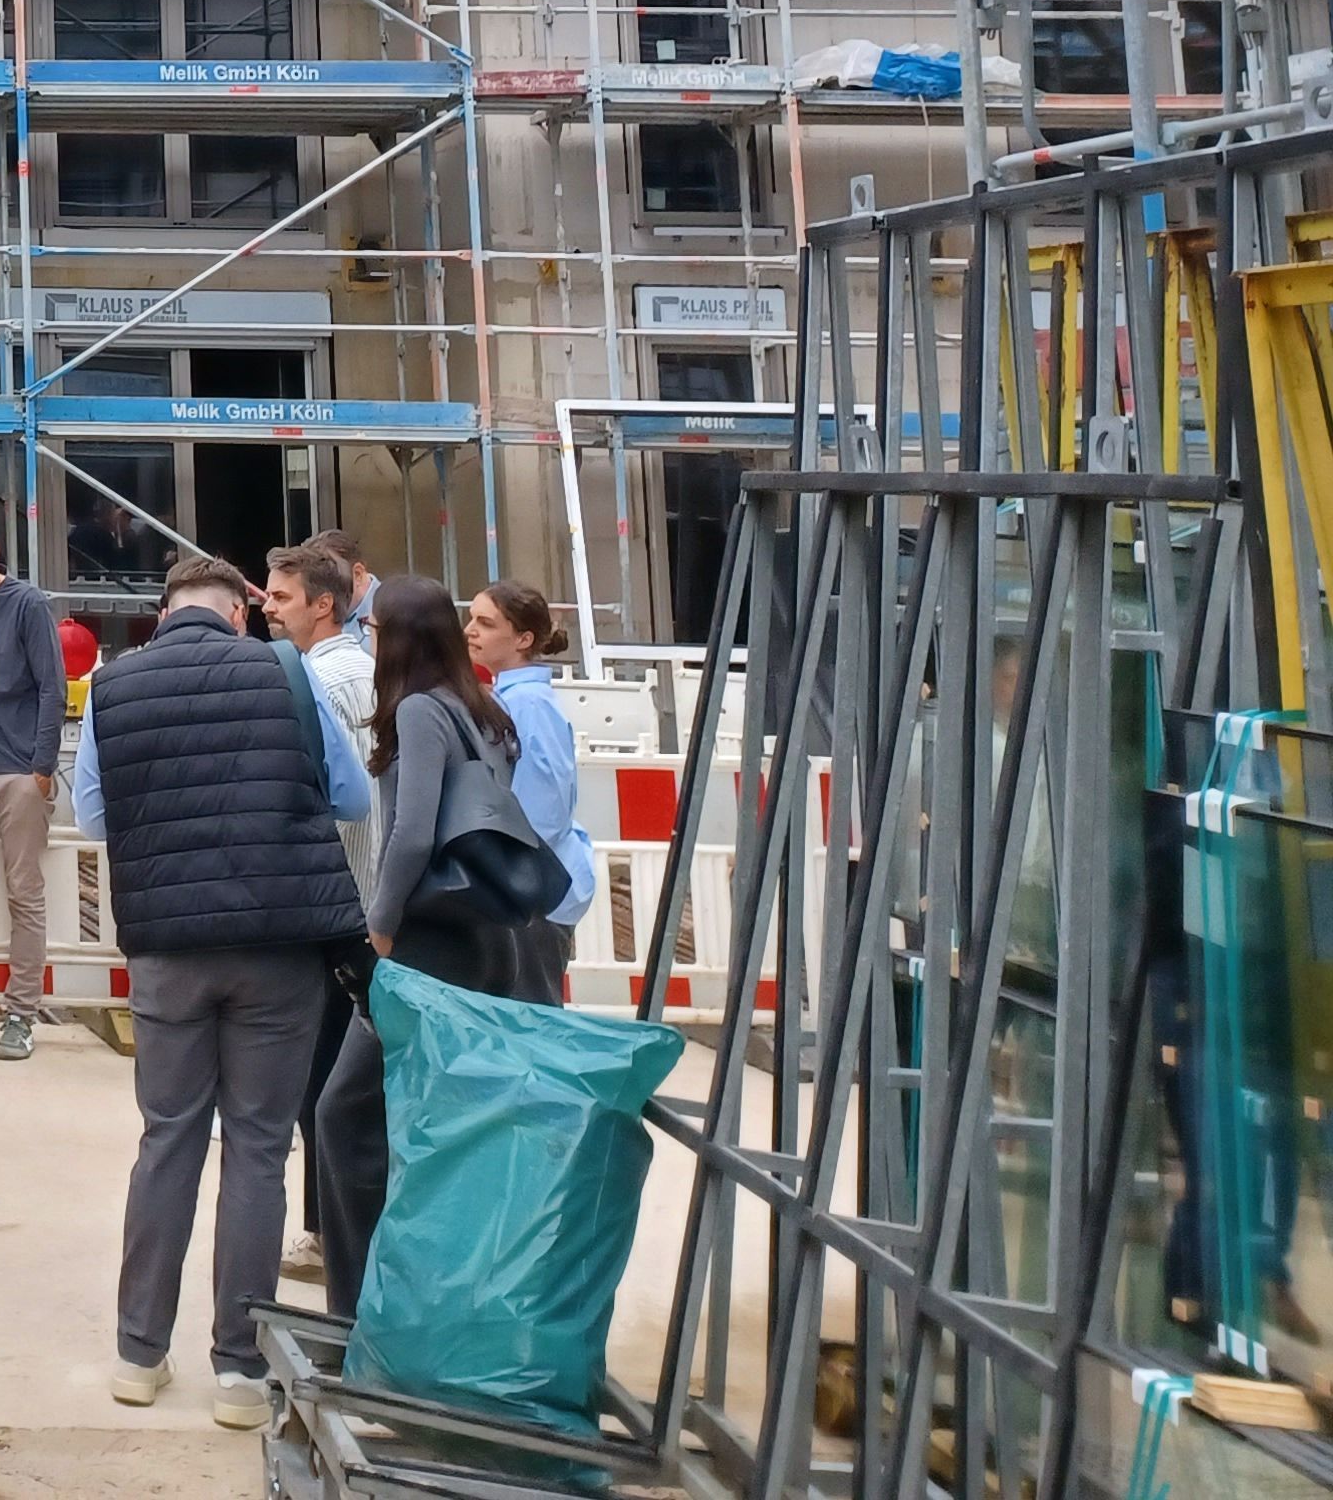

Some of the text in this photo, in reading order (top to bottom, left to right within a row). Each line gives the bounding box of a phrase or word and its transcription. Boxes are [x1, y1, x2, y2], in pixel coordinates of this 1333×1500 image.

[160, 64, 319, 81] Melik GmbH Köln
[79, 297, 133, 313] KLAUS
[681, 299, 727, 313] KLAUS
[171, 403, 334, 420] Melik GmbH Köln
